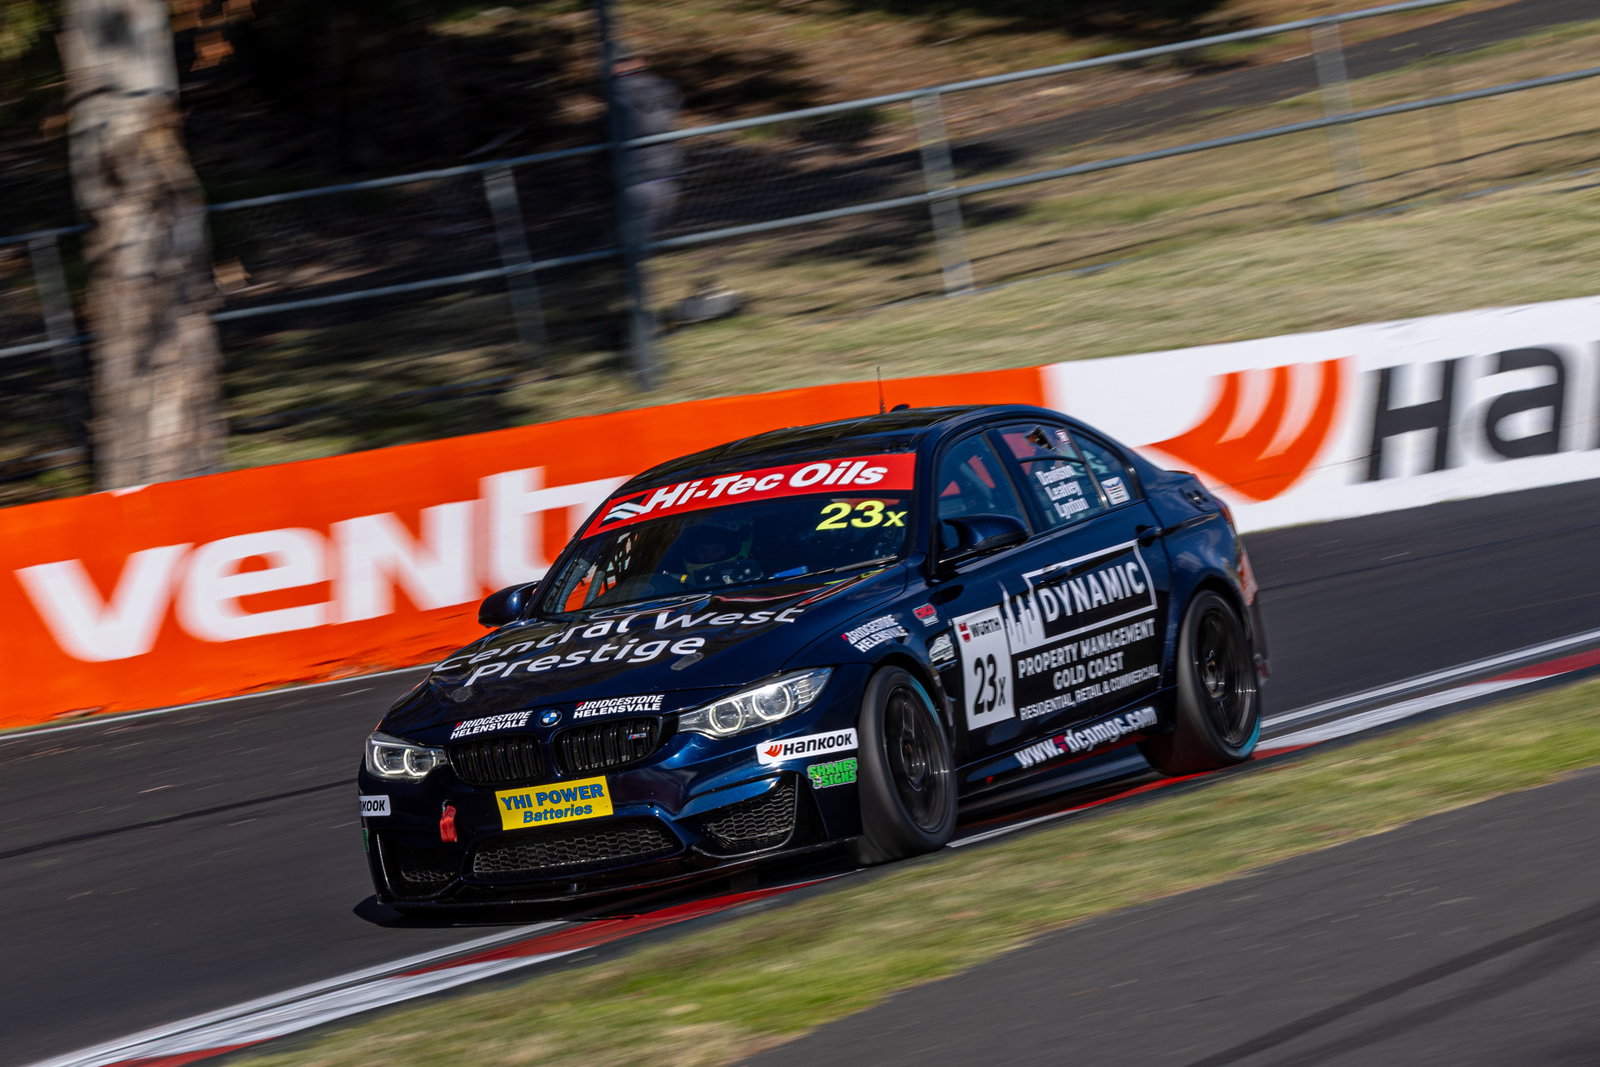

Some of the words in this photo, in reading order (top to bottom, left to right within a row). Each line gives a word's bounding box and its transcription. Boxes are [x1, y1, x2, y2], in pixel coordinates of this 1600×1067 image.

[1342, 340, 1600, 486] Ha
[640, 473, 785, 514] Hi-Tec
[788, 460, 889, 488] Oils
[1037, 561, 1146, 623] DYNAMIC
[433, 613, 642, 673] Central
[654, 606, 805, 631] West
[1017, 646, 1079, 679] PROPERTY
[1078, 618, 1156, 659] MANAGEMENT
[1053, 665, 1086, 690] GOLD
[1087, 651, 1125, 683] COAST
[572, 702, 662, 719] HELENSVALE
[574, 694, 665, 711] BRIDGESTONE
[450, 719, 528, 740] HELENSVALE
[453, 710, 534, 731] BRIDGESTONE
[360, 799, 386, 812] KOOK
[501, 791, 533, 811] YHI
[537, 784, 604, 807] POWER
[523, 804, 593, 824] Batteries
